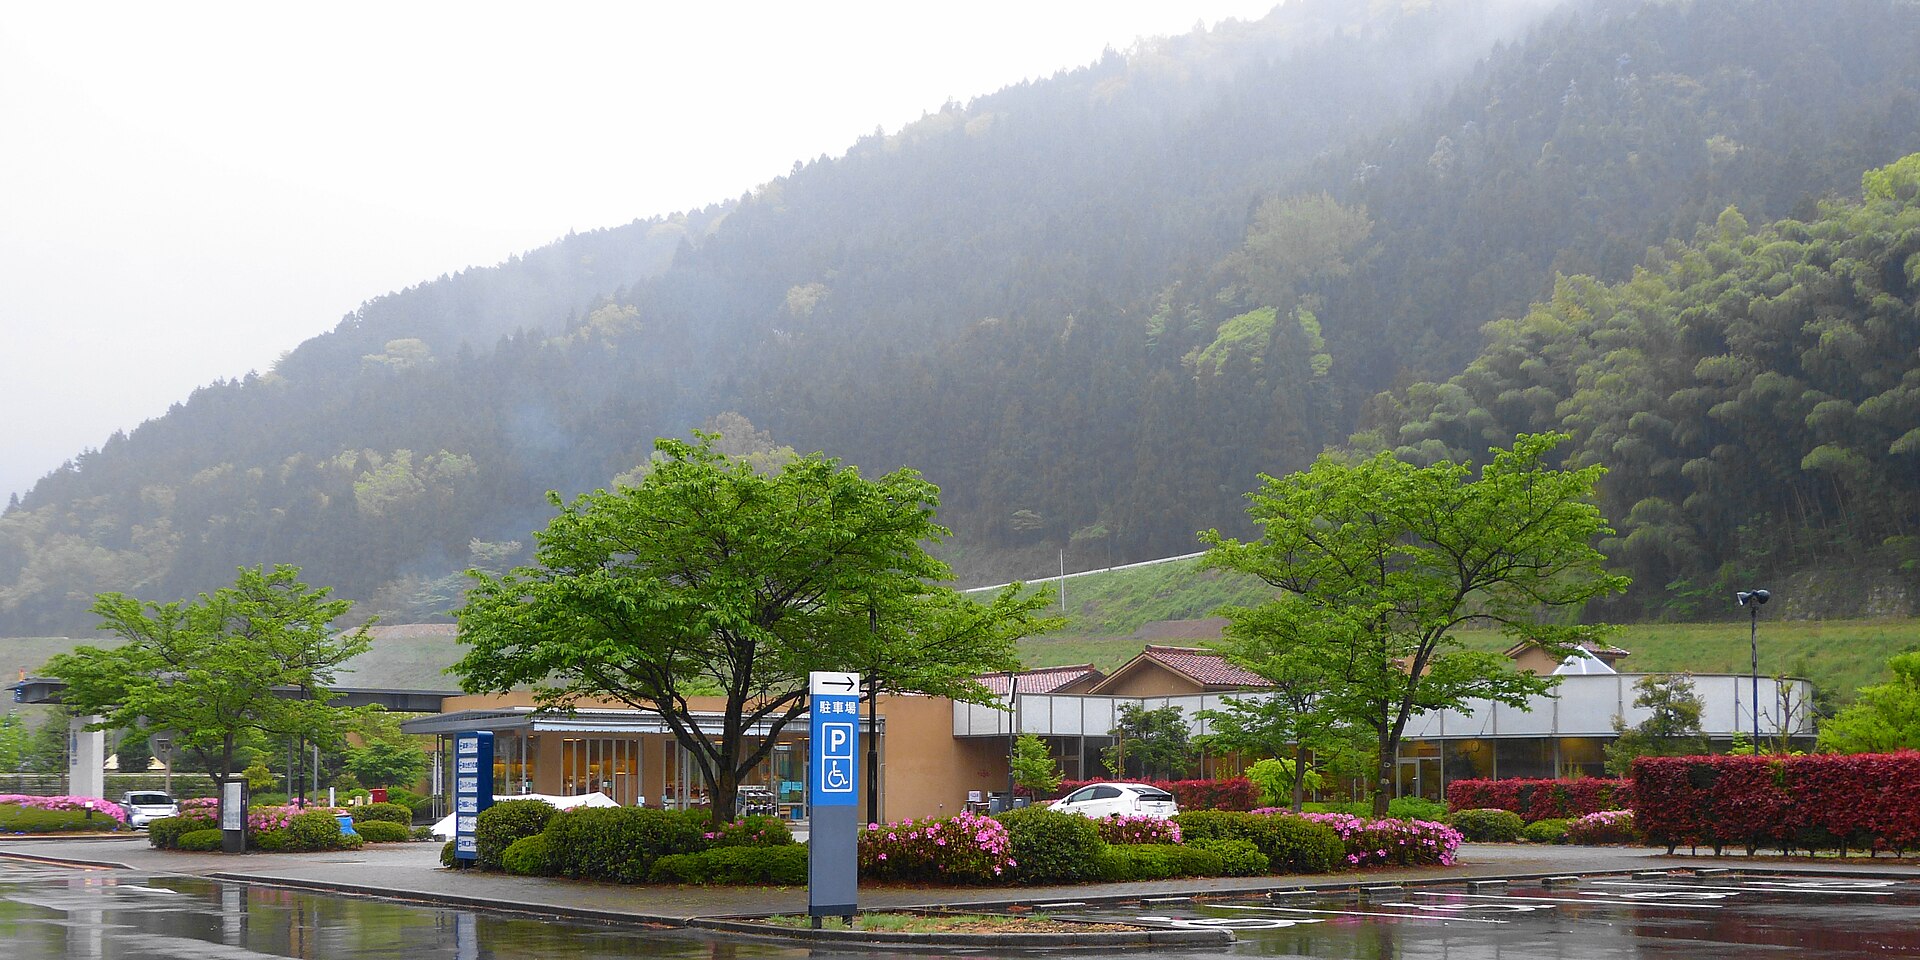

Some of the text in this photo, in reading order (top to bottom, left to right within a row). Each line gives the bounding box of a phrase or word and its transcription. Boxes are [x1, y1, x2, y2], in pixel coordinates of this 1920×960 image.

[820, 701, 856, 714] 駐車場
[831, 730, 846, 752] P
